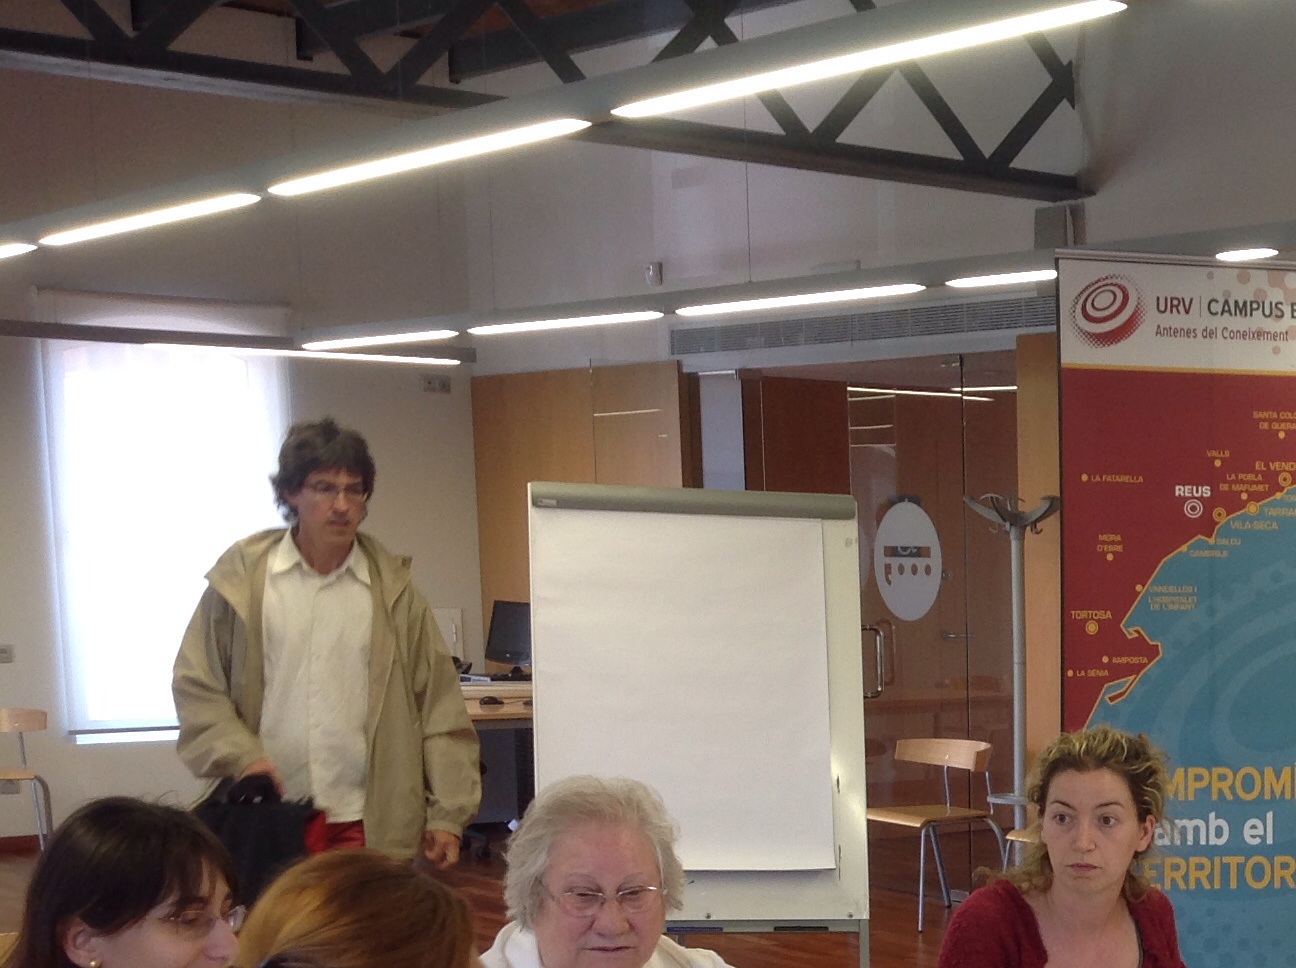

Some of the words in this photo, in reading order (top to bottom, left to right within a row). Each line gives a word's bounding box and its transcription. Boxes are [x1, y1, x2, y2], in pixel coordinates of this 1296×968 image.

[1156, 296, 1193, 315] URV
[1207, 298, 1284, 319] CAMPUS
[1155, 324, 1198, 339] Antenes
[1201, 326, 1218, 340] del
[1221, 326, 1289, 343] Coneixement
[1253, 411, 1278, 419] SANTA
[1259, 421, 1269, 430] DE
[1255, 461, 1267, 471] EL
[1091, 474, 1101, 482] LA
[1102, 474, 1144, 483] FATARELLA
[1226, 473, 1236, 481] LA
[1175, 485, 1211, 497] REUS
[1219, 483, 1230, 491] DE
[1071, 610, 1112, 620] TORTOSA
[1112, 656, 1148, 664] AMPOSTA
[1076, 669, 1086, 677] LA
[1154, 811, 1230, 846] amb
[1243, 810, 1274, 845] el
